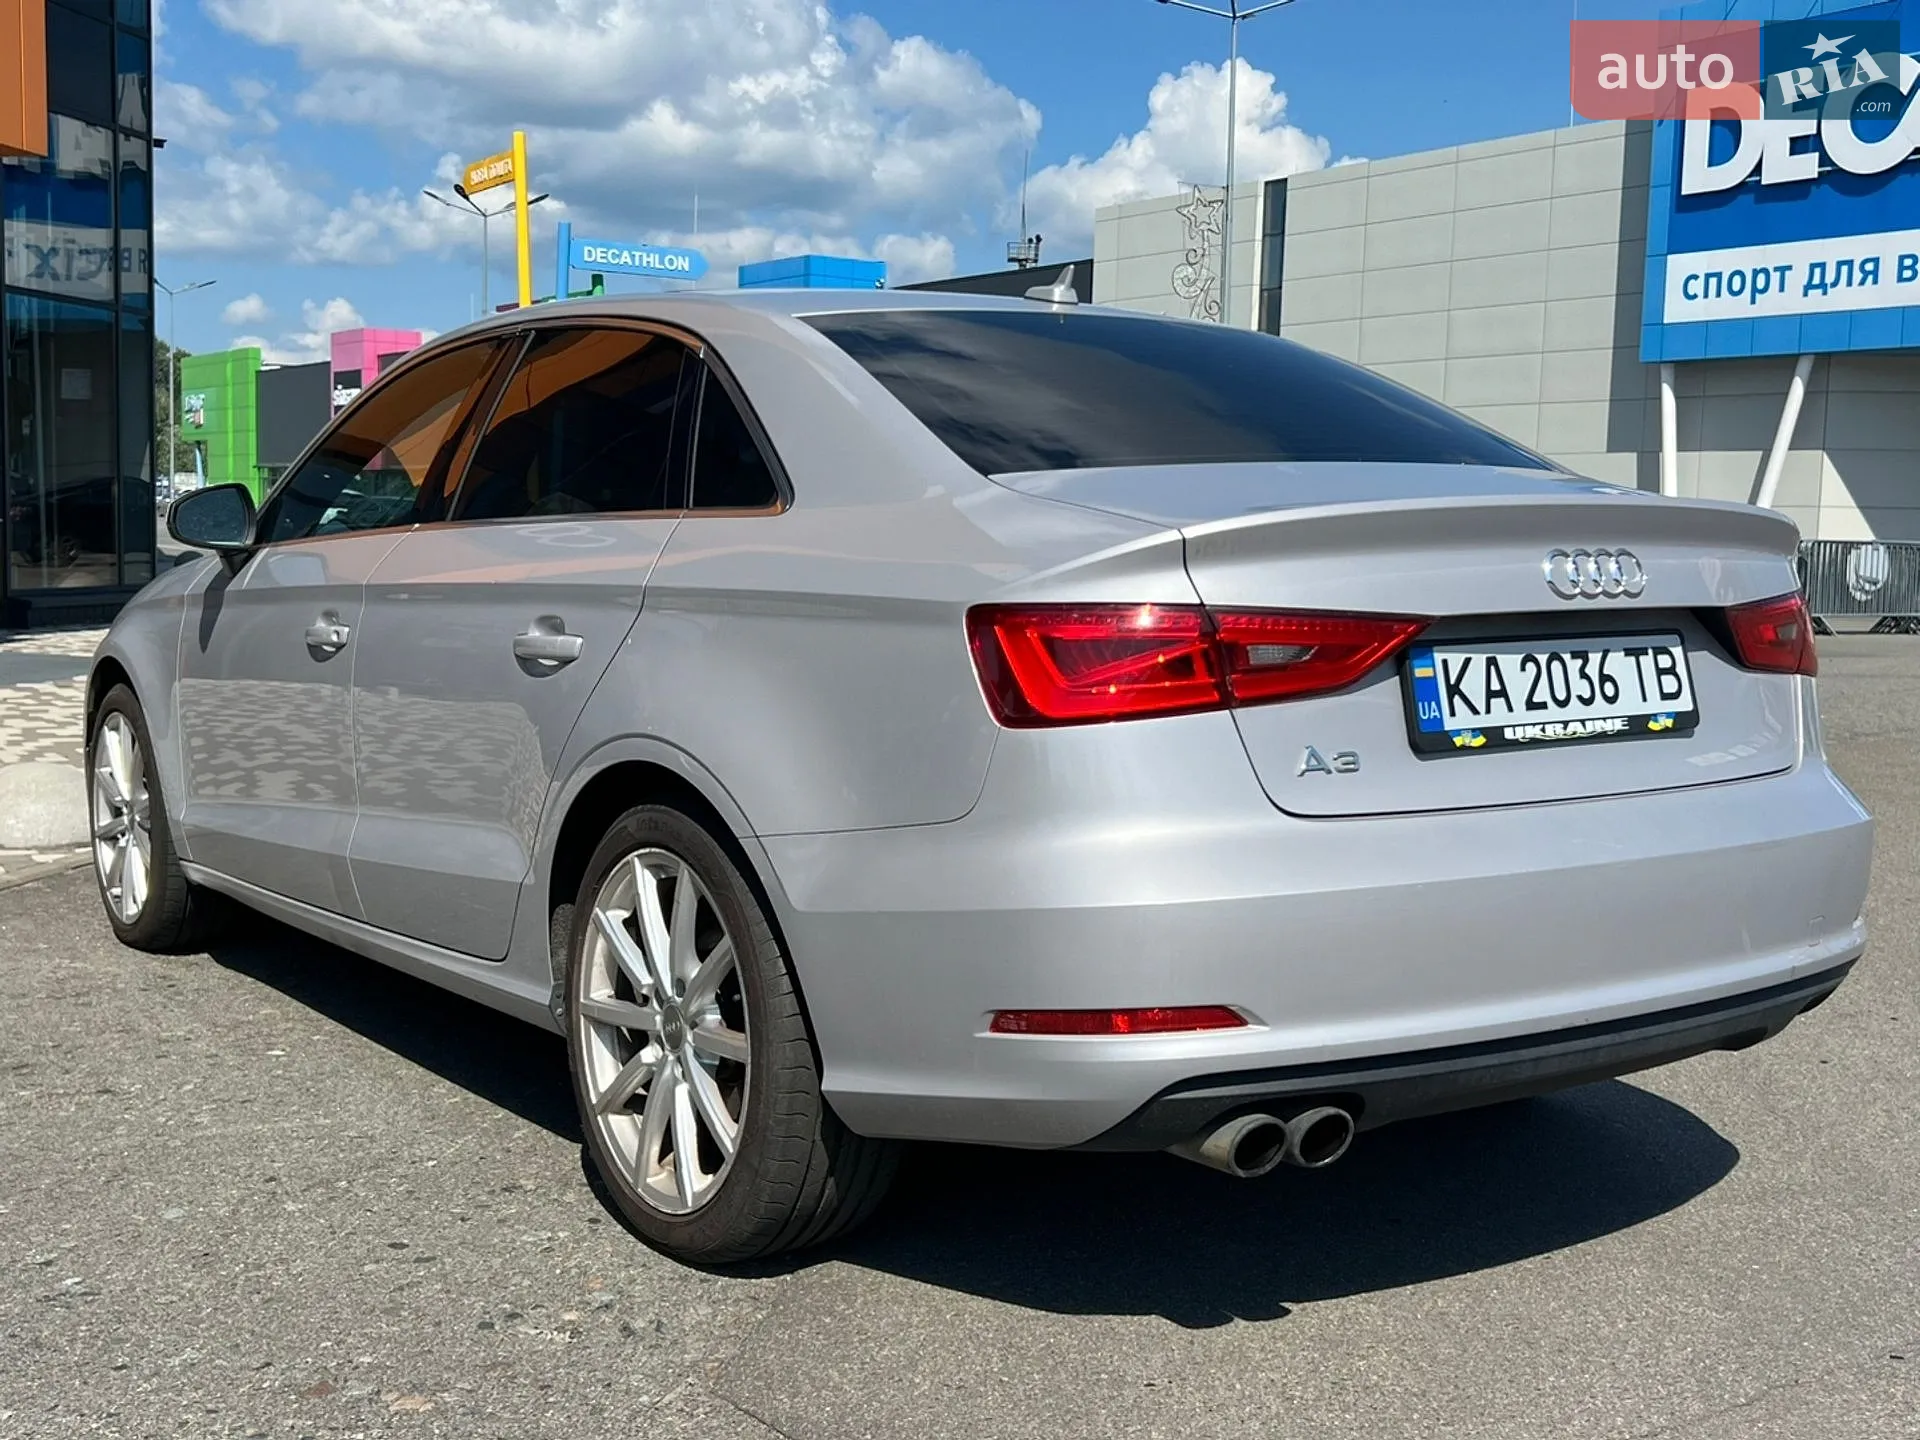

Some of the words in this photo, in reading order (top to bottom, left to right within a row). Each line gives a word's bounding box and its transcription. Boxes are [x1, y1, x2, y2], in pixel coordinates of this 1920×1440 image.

[1681, 52, 1920, 195] DEC
[583, 245, 690, 272] DECATHLON
[1682, 264, 1793, 305] спорт
[1802, 256, 1880, 298] для
[1441, 655, 1514, 718] KA
[1520, 649, 1620, 711] 2036
[1624, 645, 1683, 703] TB
[1419, 701, 1441, 720] UA
[1503, 717, 1630, 742] UKRAINE
[1297, 745, 1360, 777] A3
